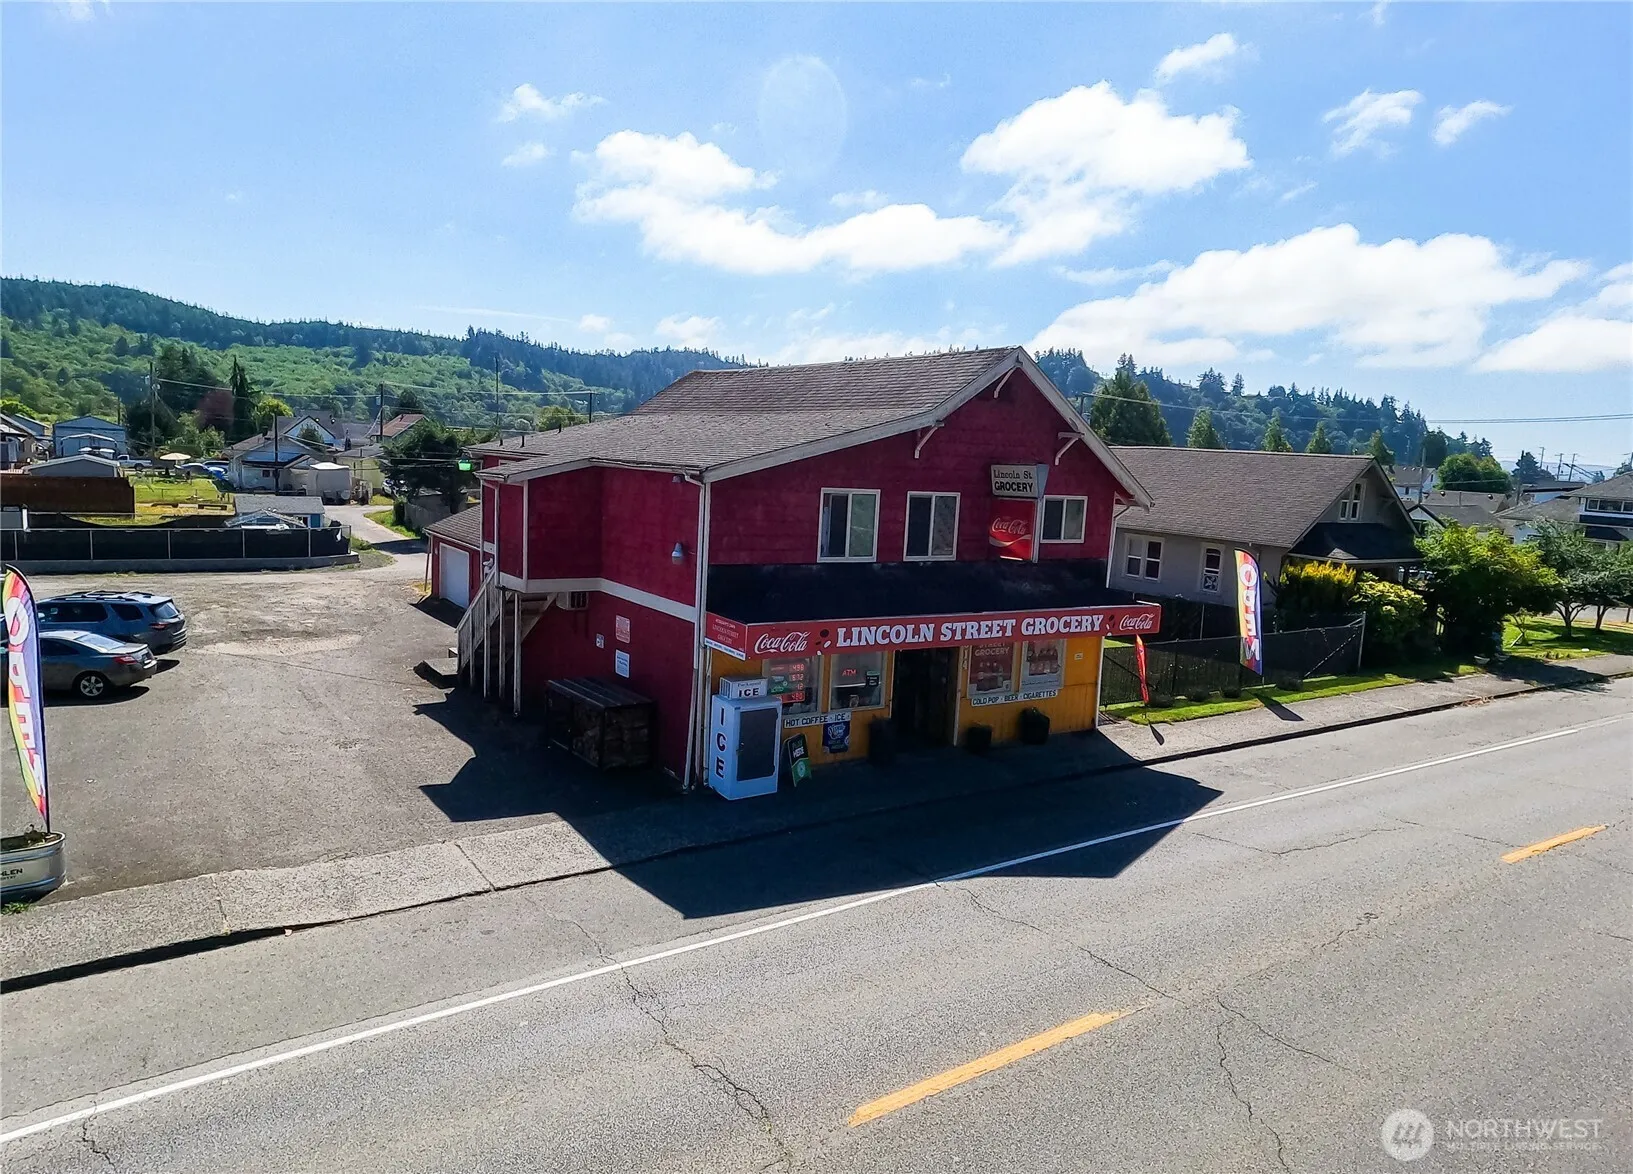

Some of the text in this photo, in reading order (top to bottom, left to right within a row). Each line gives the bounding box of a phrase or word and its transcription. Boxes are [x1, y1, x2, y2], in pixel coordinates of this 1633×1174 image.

[993, 469, 1020, 479] Lincoln
[994, 481, 1034, 493] GROCERY
[1119, 613, 1155, 631] Coca-Cola
[836, 614, 1104, 647] LINCOLN STREET GROCERY
[754, 631, 811, 654] Coca-Cola
[974, 647, 1010, 657] GROCERY
[738, 687, 760, 698] ICE
[972, 697, 987, 705] COLD
[987, 696, 1000, 704] POP
[1023, 689, 1057, 699] CIGARETTES
[785, 712, 846, 727] HOT COFFEE ICE
[715, 706, 727, 779] ICE
